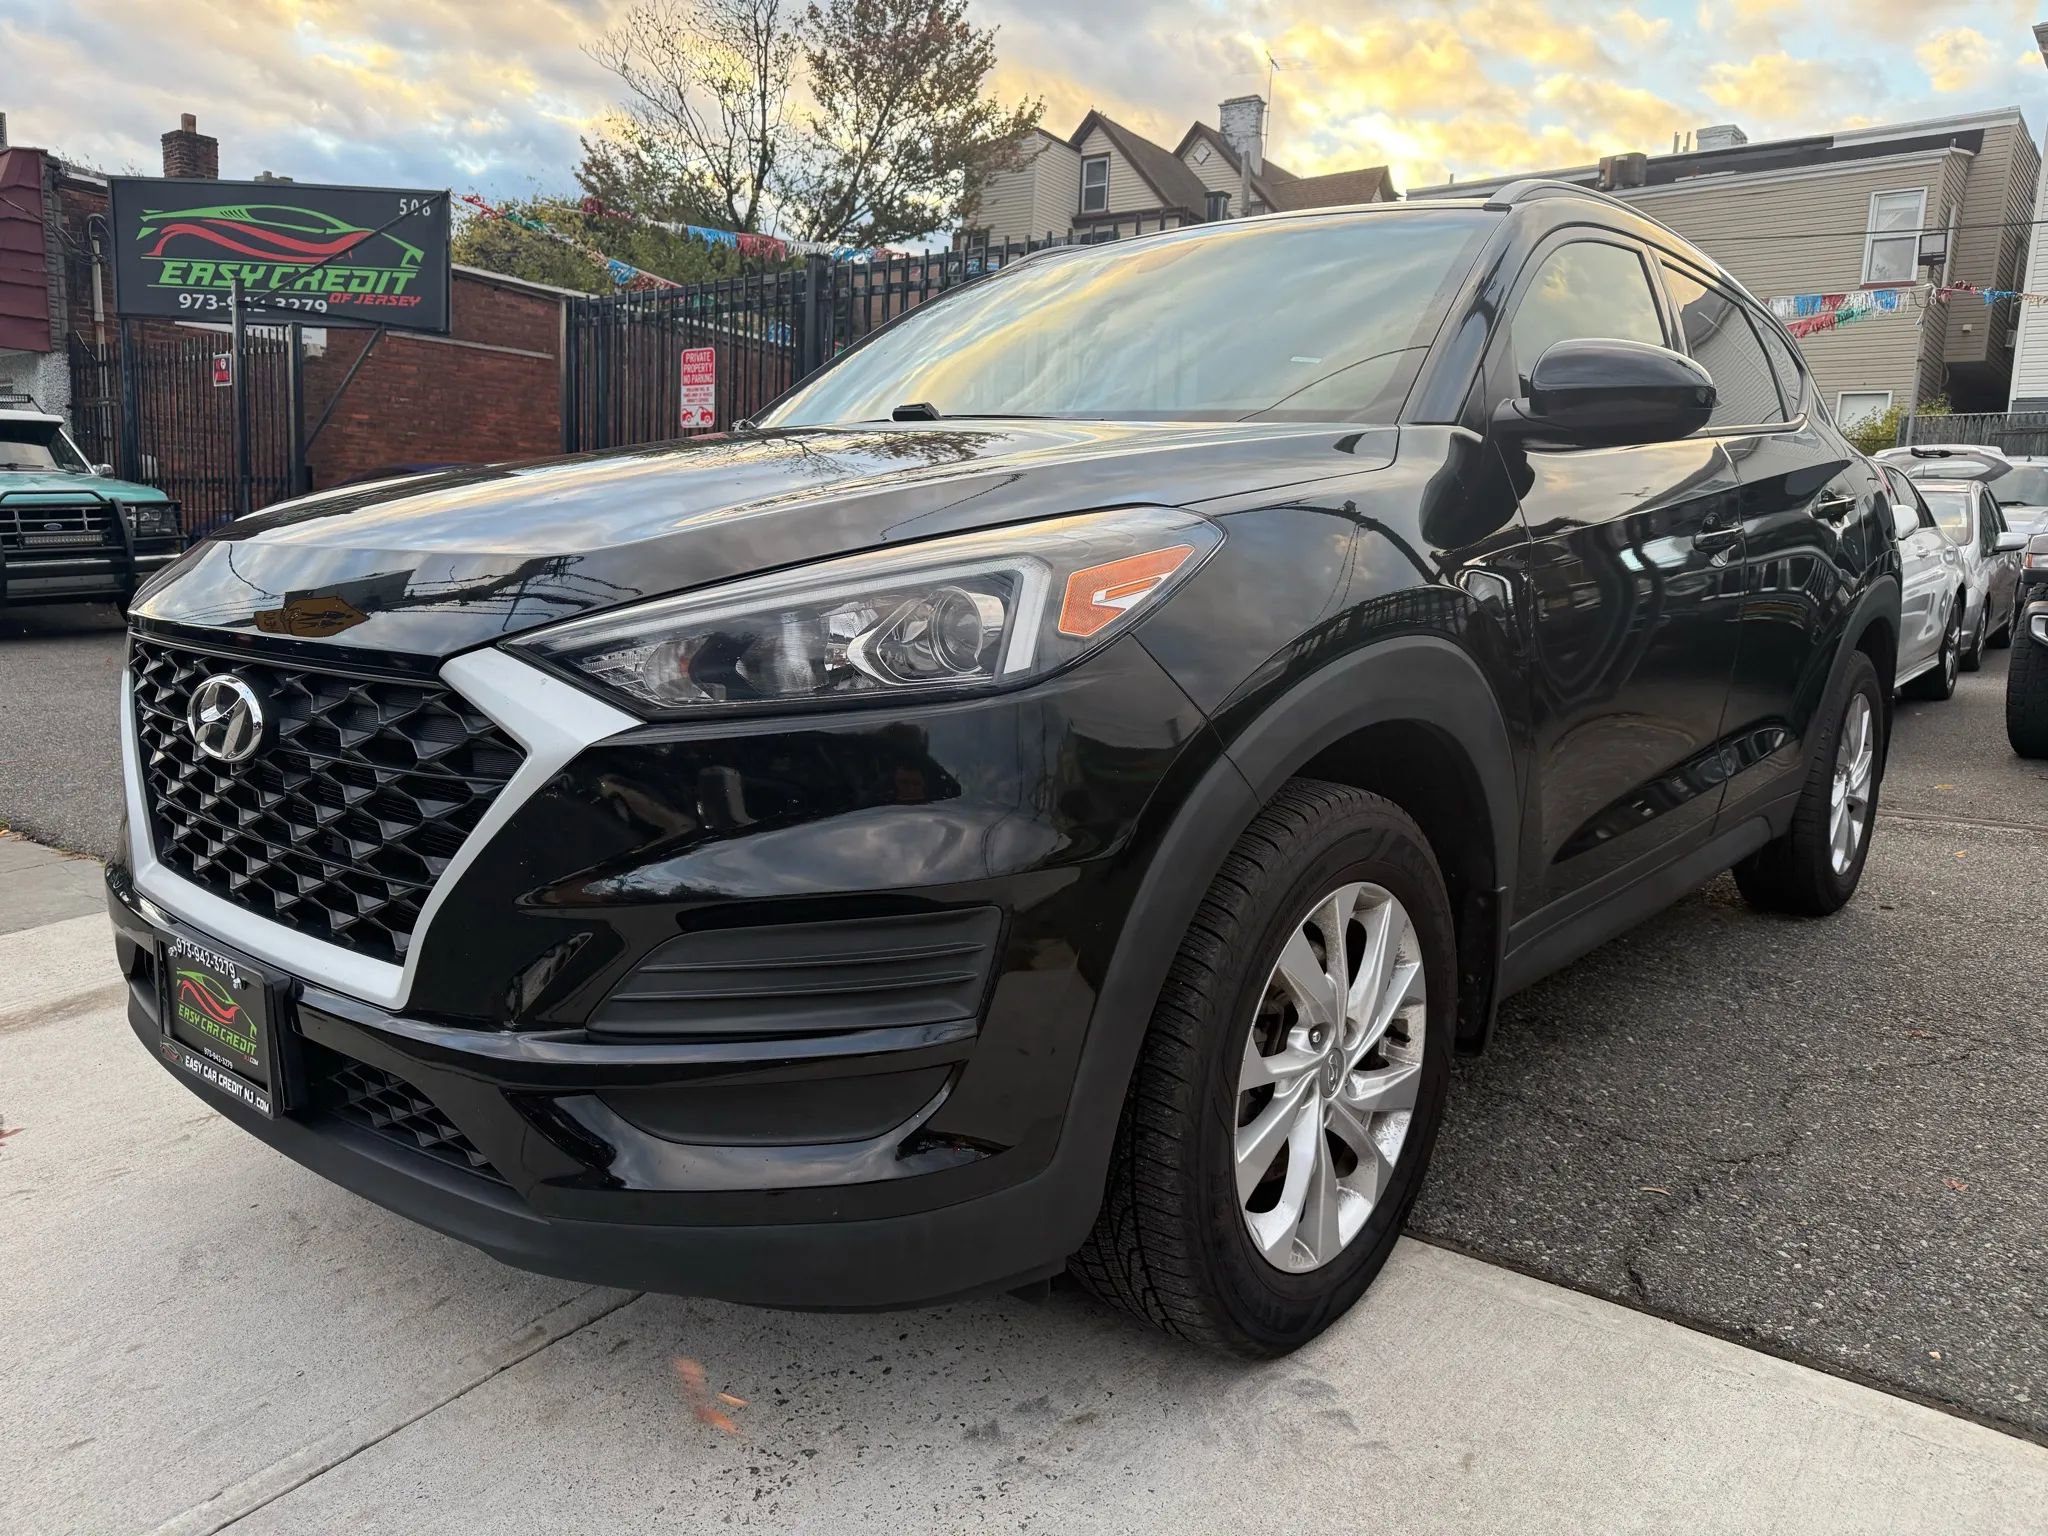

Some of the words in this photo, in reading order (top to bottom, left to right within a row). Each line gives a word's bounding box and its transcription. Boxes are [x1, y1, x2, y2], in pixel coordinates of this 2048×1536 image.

[159, 261, 267, 289] EASY
[269, 265, 417, 294] CREDIT
[329, 292, 351, 304] OF
[353, 294, 422, 307] JERSEY
[684, 362, 712, 373] PROPERTY
[685, 352, 711, 363] PRIVATE
[176, 938, 236, 979] 973-942-3279
[178, 1004, 200, 1024] EASY
[201, 1017, 220, 1037] CAR
[220, 1028, 256, 1056] CREDIT
[185, 1055, 203, 1074] EASY
[203, 1066, 217, 1083] CAR
[218, 1074, 243, 1097] CREDIT
